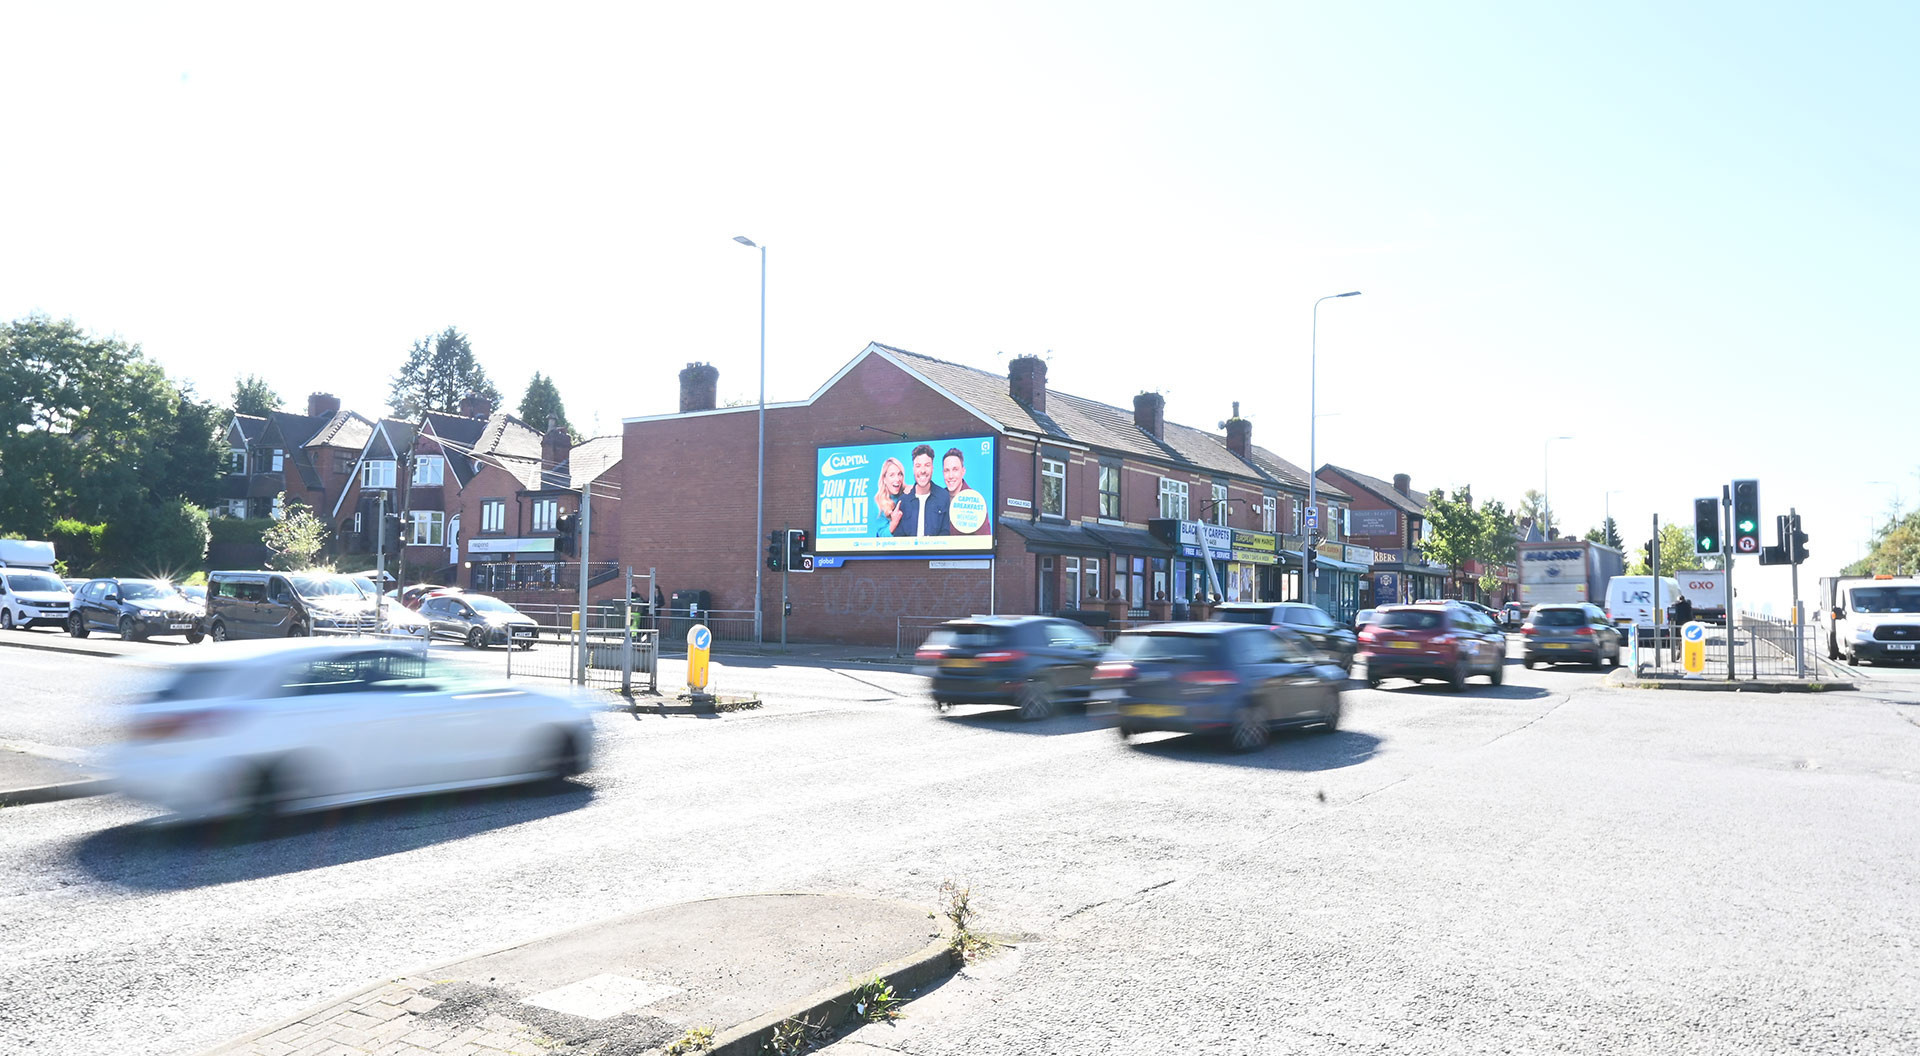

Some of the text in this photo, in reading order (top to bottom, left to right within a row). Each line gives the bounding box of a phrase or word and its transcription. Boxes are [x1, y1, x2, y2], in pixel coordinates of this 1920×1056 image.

[832, 454, 869, 467] CAPITAL
[820, 478, 869, 497] JOIN THE
[958, 495, 980, 503] CAPITAL
[821, 497, 868, 525] CHAT!
[953, 502, 984, 510] BREAKFAST
[1209, 527, 1230, 540] CARPETS
[1185, 547, 1195, 556] FREE
[1216, 550, 1230, 560] SERVICE
[1374, 551, 1396, 562] RBERS
[818, 558, 834, 566] global
[1689, 581, 1714, 589] GXO
[1622, 591, 1651, 603] LAR
